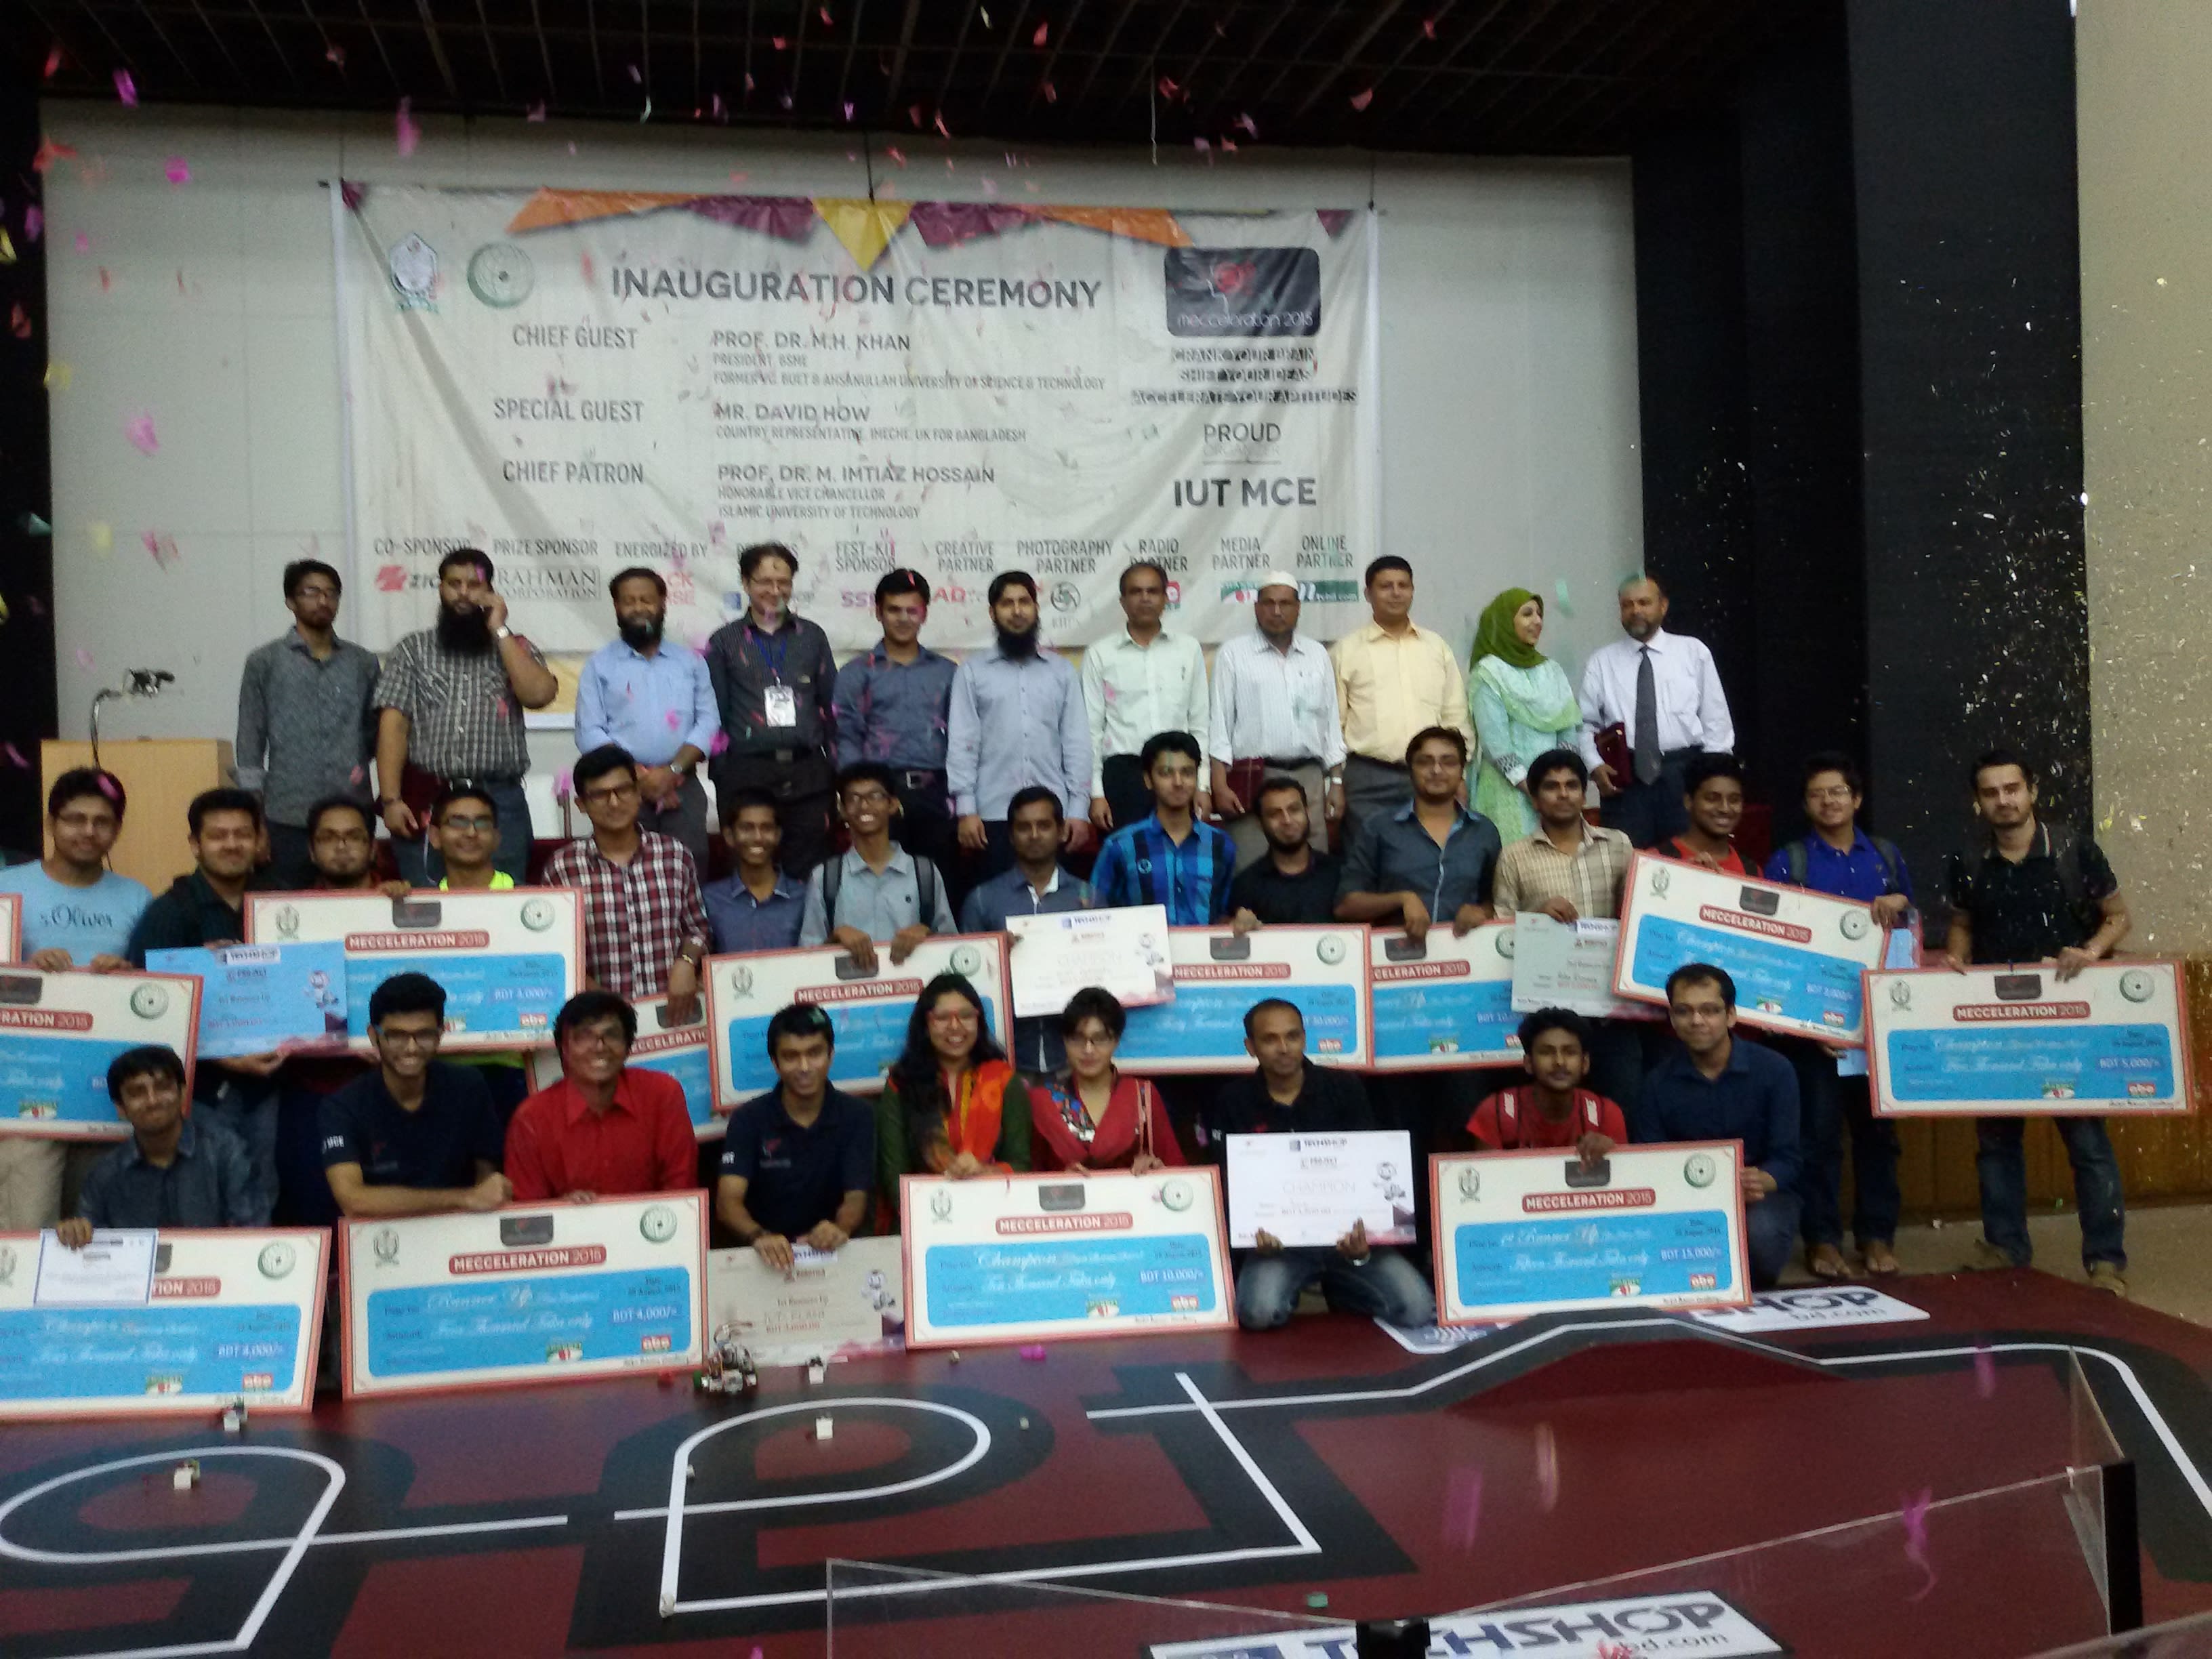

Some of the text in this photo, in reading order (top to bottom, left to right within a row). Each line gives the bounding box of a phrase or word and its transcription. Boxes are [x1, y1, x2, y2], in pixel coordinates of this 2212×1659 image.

[612, 268, 1101, 308] INAUGURATION CEREMONY
[513, 324, 638, 349] CHIEF GUEST
[712, 330, 768, 348] PROF.
[775, 331, 807, 348] DR.
[856, 333, 911, 351] KHAN
[494, 398, 644, 423] SPECIAL GUEST
[715, 403, 870, 422] MR. DAVID HOW
[1204, 422, 1282, 442] PROUD
[502, 460, 644, 484] CHIEF PATRON
[779, 465, 811, 483] DR.
[817, 466, 836, 483] M.
[842, 466, 906, 483] IMTIAZ
[912, 466, 994, 483] HOSSAIN
[1174, 477, 1317, 507] IUT MCE
[494, 539, 598, 555] PRIZE SPONSOR
[691, 541, 708, 558] BY
[935, 541, 995, 556] CREATIVE
[1017, 539, 1113, 557] PHOTOGRAPHY
[1139, 538, 1179, 553] RADIO
[1221, 537, 1261, 552] MEDIA
[1302, 535, 1347, 552] ONLINE
[836, 556, 896, 573] SPONSOR
[939, 557, 995, 573] PARTNER
[1037, 557, 1097, 574] PARTNER
[1212, 553, 1271, 570] PARTNER
[1296, 552, 1353, 569] PARTNER
[498, 567, 597, 586] RAHMAN
[1956, 1006, 2057, 1019] MECCELERATION
[1525, 1193, 1624, 1209] MECCELERATION
[1000, 1216, 1101, 1232] MECCELERATION
[453, 1250, 569, 1271] MECCELERATION
[613, 1309, 632, 1322] BDT
[1305, 1602, 1725, 1659] THSHOP
